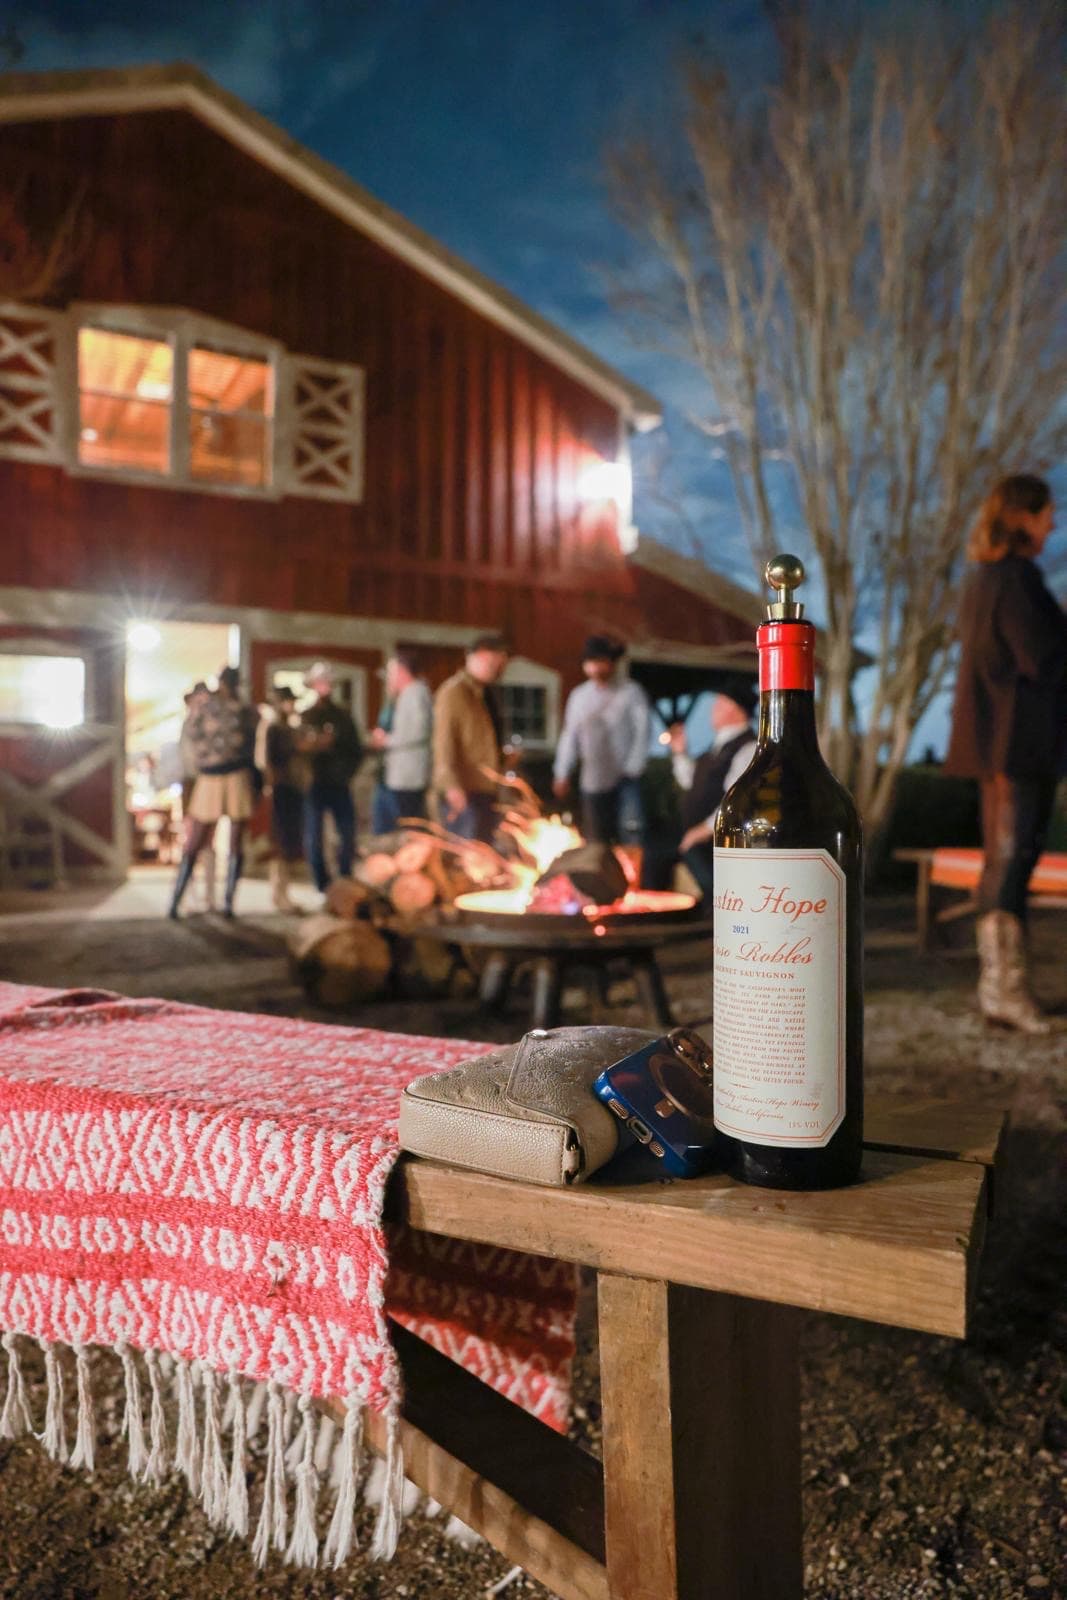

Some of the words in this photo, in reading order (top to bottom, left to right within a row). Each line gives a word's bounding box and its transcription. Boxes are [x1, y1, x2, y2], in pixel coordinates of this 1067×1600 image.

[750, 885, 828, 923] Hope
[732, 925, 749, 935] 2021
[736, 937, 814, 964] Robles
[740, 970, 795, 979] SAUVIGNON
